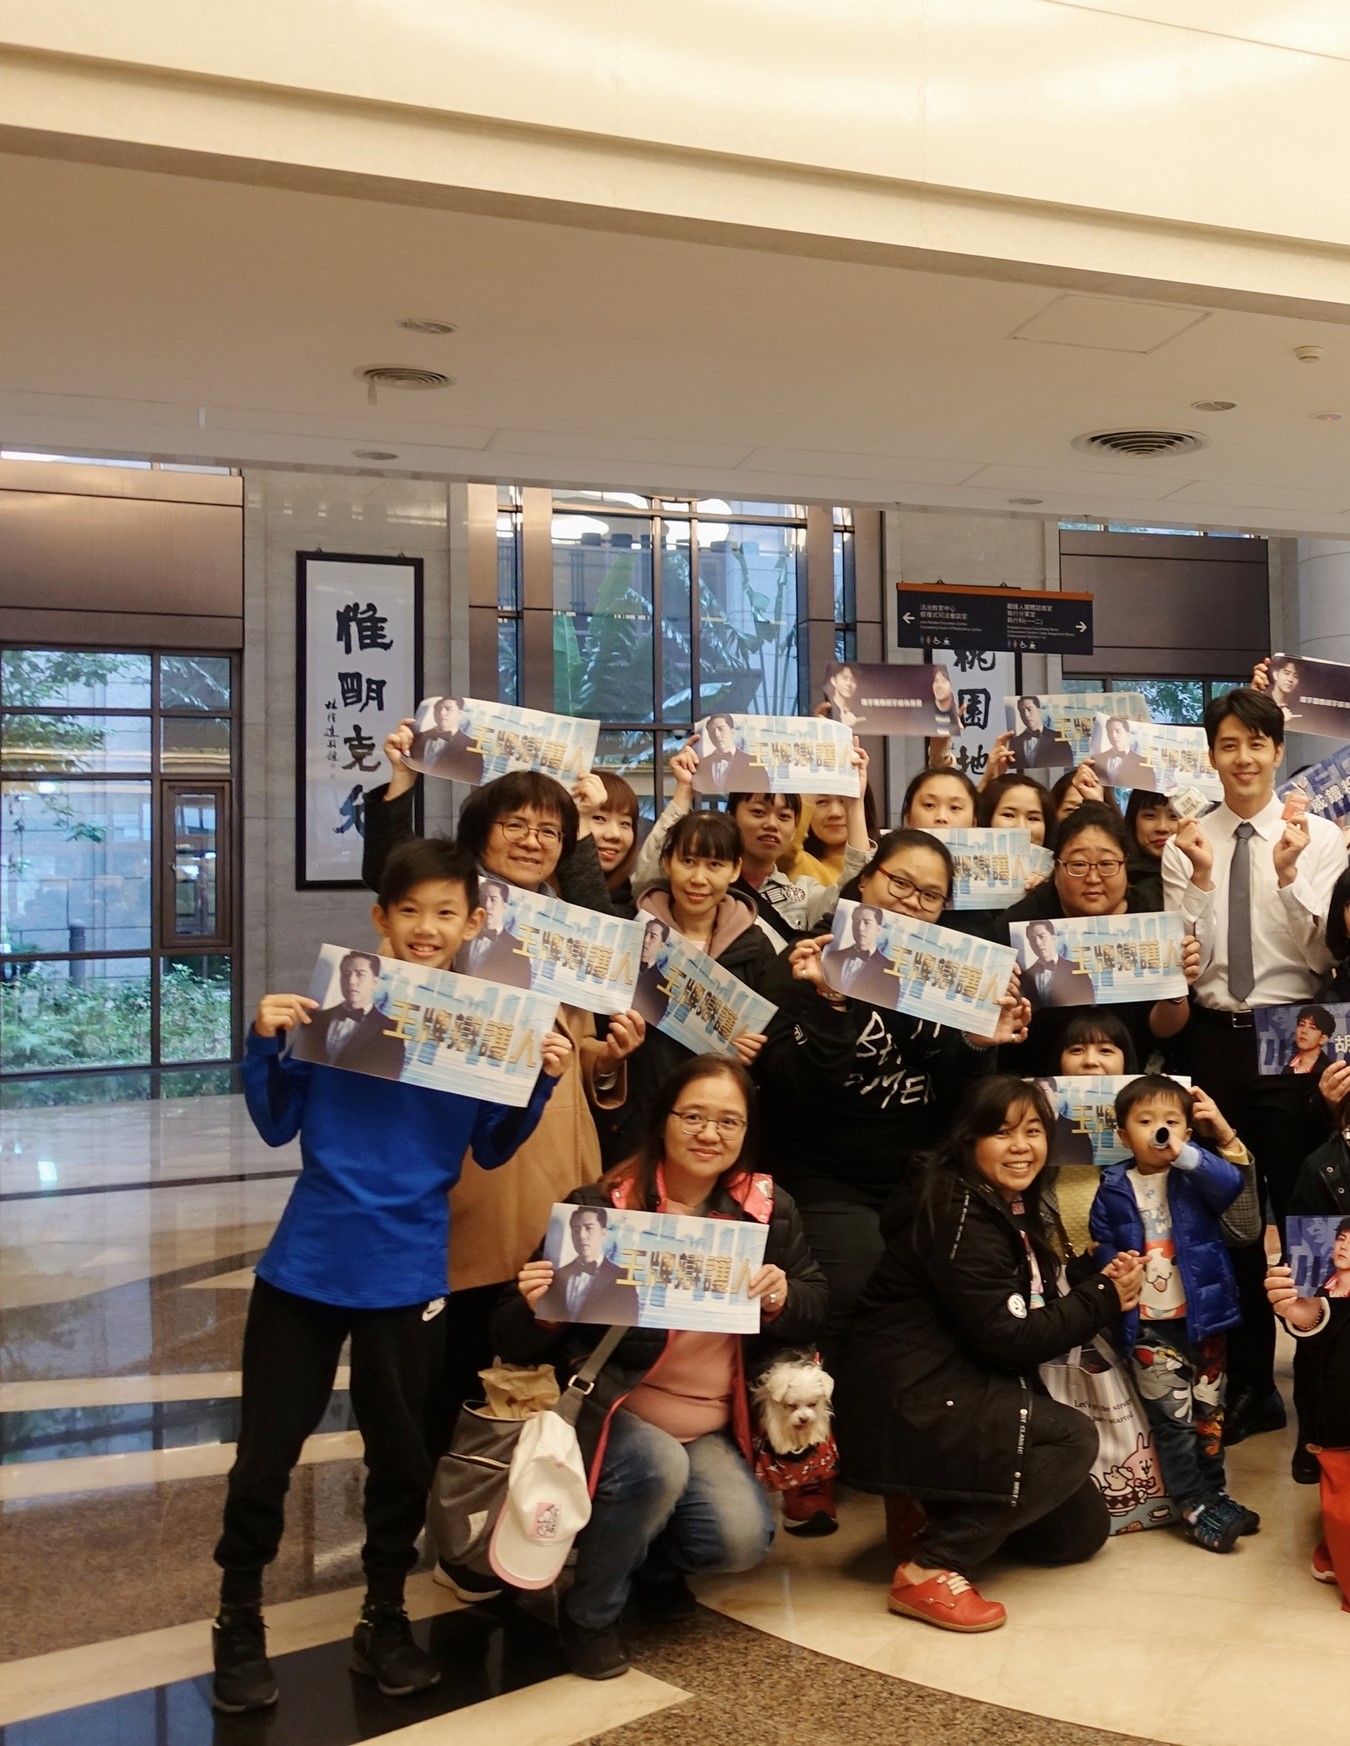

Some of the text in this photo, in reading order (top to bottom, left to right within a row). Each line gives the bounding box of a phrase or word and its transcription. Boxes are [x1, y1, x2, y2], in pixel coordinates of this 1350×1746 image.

[1139, 746, 1215, 775] 王牌辯護
[953, 853, 1028, 881] 牌辯護人
[512, 923, 633, 986] 王牌辯護人
[883, 944, 1000, 1004] 王牌辯護人
[1072, 939, 1183, 975] 王牌辯護人
[383, 1000, 537, 1069] 王牌辯護人
